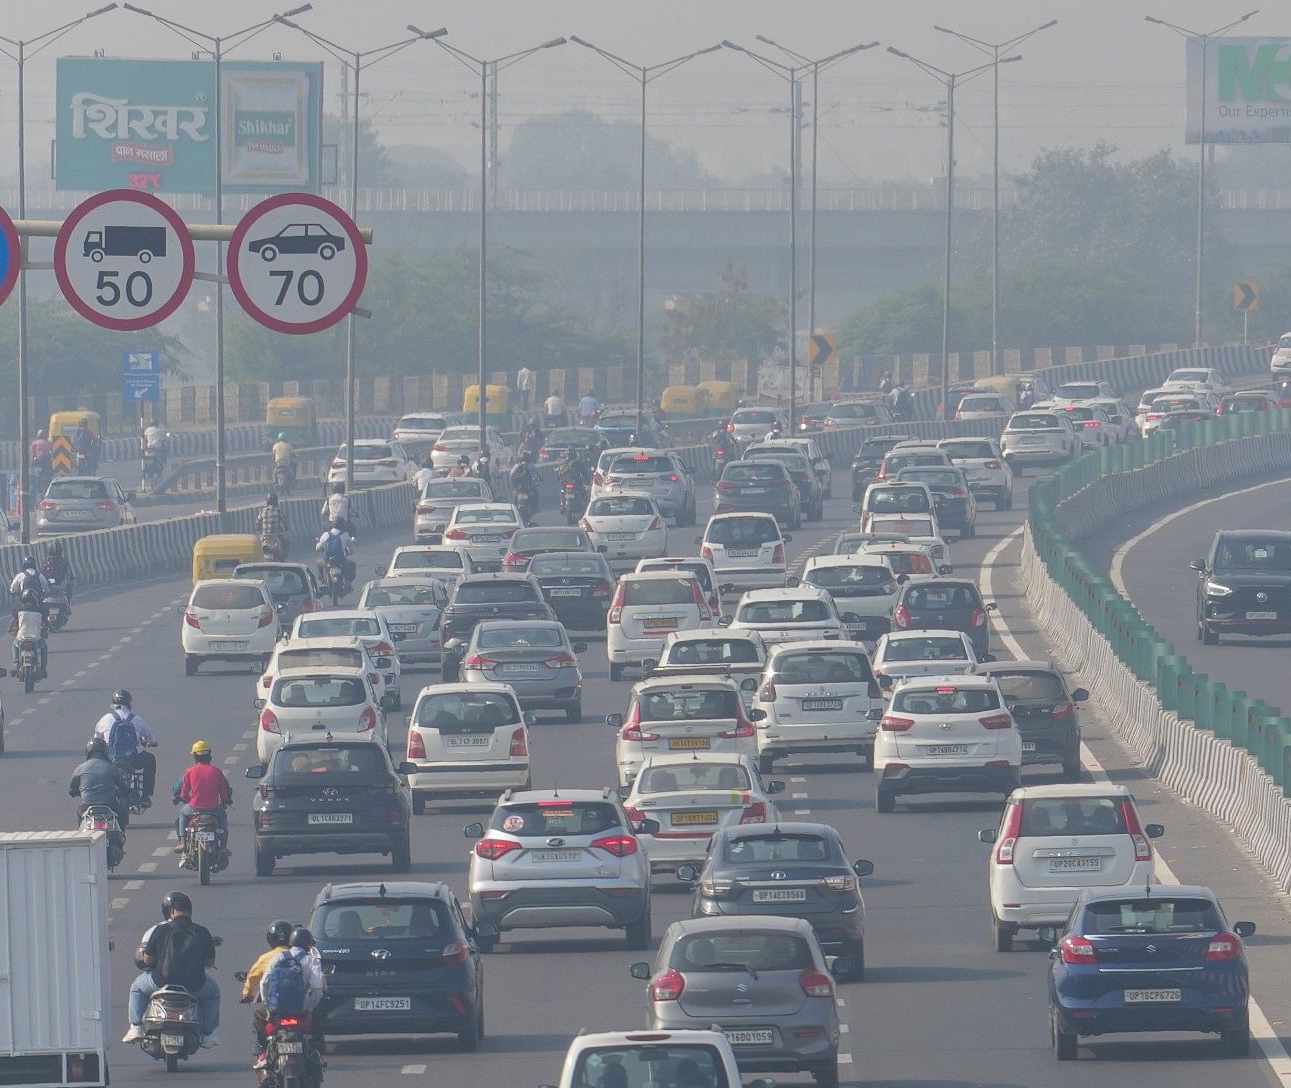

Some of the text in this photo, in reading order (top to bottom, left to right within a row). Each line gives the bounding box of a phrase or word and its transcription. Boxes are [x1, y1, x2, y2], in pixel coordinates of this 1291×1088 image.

[70, 92, 209, 141] शिखर
[1219, 105, 1241, 117] Our
[238, 119, 291, 136] Shikhar
[115, 146, 134, 157] पान
[96, 270, 153, 307] 50
[269, 269, 325, 306] 70
